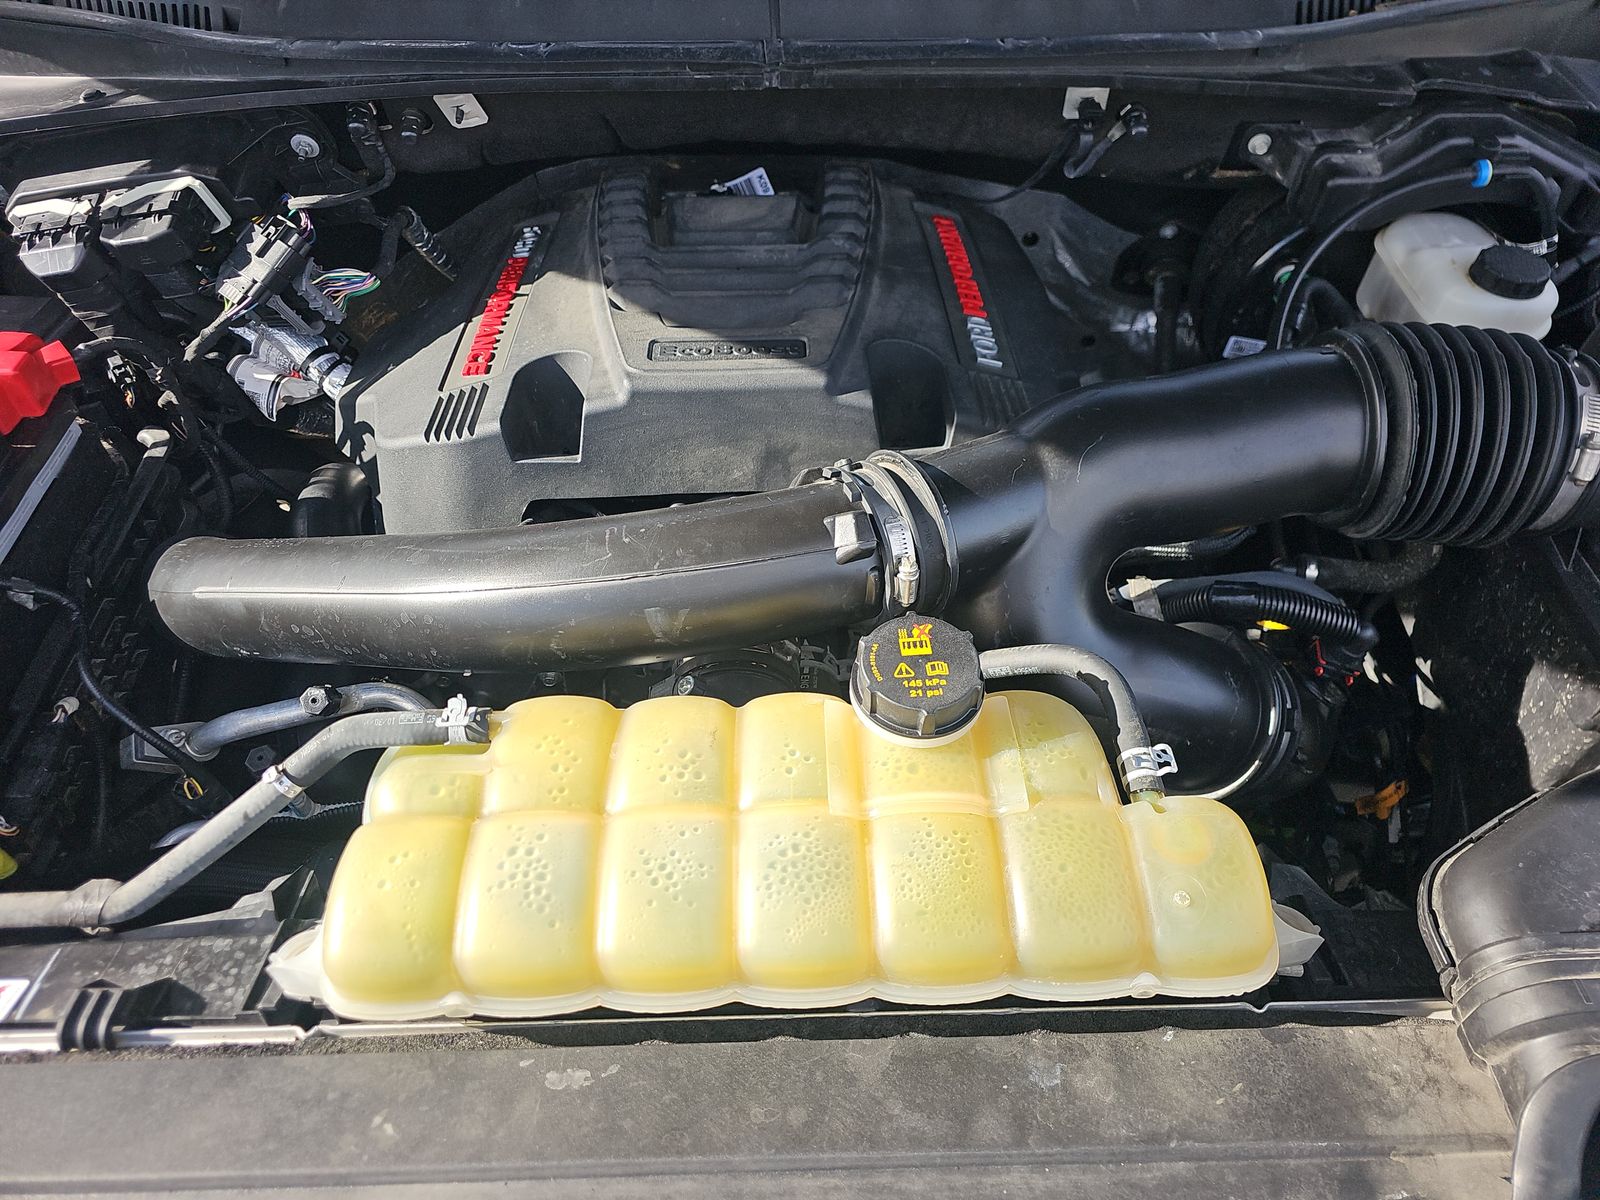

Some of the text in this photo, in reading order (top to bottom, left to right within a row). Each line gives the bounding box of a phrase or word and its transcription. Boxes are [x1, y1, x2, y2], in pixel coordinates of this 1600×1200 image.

[931, 214, 1003, 368] FORD PERFORMAN
[461, 257, 529, 377] PERFORMANCE
[657, 344, 801, 358] EcoBoost
[902, 678, 947, 688] 145 kPa
[909, 688, 944, 698] 21 psi
